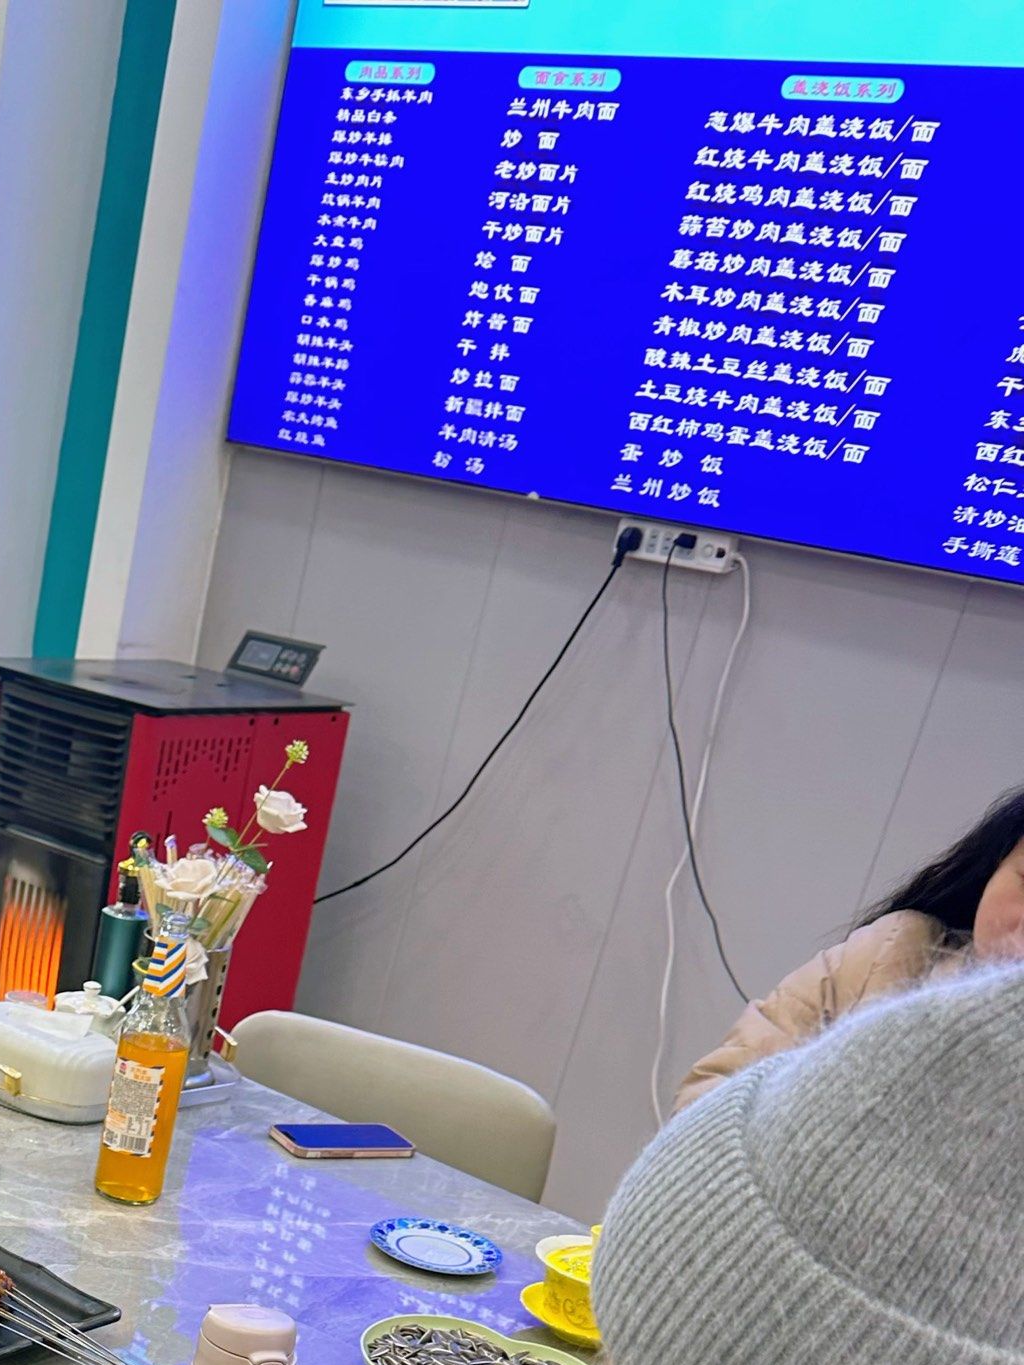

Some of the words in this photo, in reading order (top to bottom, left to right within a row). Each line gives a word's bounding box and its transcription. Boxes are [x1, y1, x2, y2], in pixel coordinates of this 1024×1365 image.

[359, 66, 422, 80] 肉品系列
[535, 71, 607, 87] 面食系列
[789, 79, 898, 98] 盖浇饭系列
[507, 98, 619, 120] 兰州牛肉面
[704, 111, 940, 142] 葱爆牛肉盖浇饭/面
[501, 130, 559, 149] 炒面
[495, 160, 578, 183] 老炒面片
[694, 146, 929, 180] 红烧牛肉盖浇饭/面
[489, 192, 570, 214] 河沿面片
[685, 181, 918, 216] 红烧鸡肉盖浇饭/面
[313, 235, 363, 250] 大盘鸡
[482, 221, 563, 245] 干炒面片
[474, 251, 532, 272] 烩面
[469, 281, 540, 304] 炮仗面
[661, 282, 885, 323] 木耳炒肉盖浇饭/面
[462, 311, 533, 333] 炸酱面
[653, 315, 874, 358] 青椒炒肉盖浇饭/面
[457, 339, 510, 361] 干拌
[450, 368, 519, 391] 炒拉面
[644, 348, 891, 396] 酸辣土豆丝盖浇饭/面
[445, 396, 525, 422] 新疆拌面
[635, 380, 880, 430] 土豆烧牛肉盖浇饭/面
[439, 424, 517, 450] 羊肉清汤
[630, 412, 870, 463] 西红柿鸡蛋盖浇饭/面
[433, 451, 484, 474] 粉汤
[620, 444, 723, 475] 蛋炒饭
[611, 474, 719, 507] 兰州炒饭
